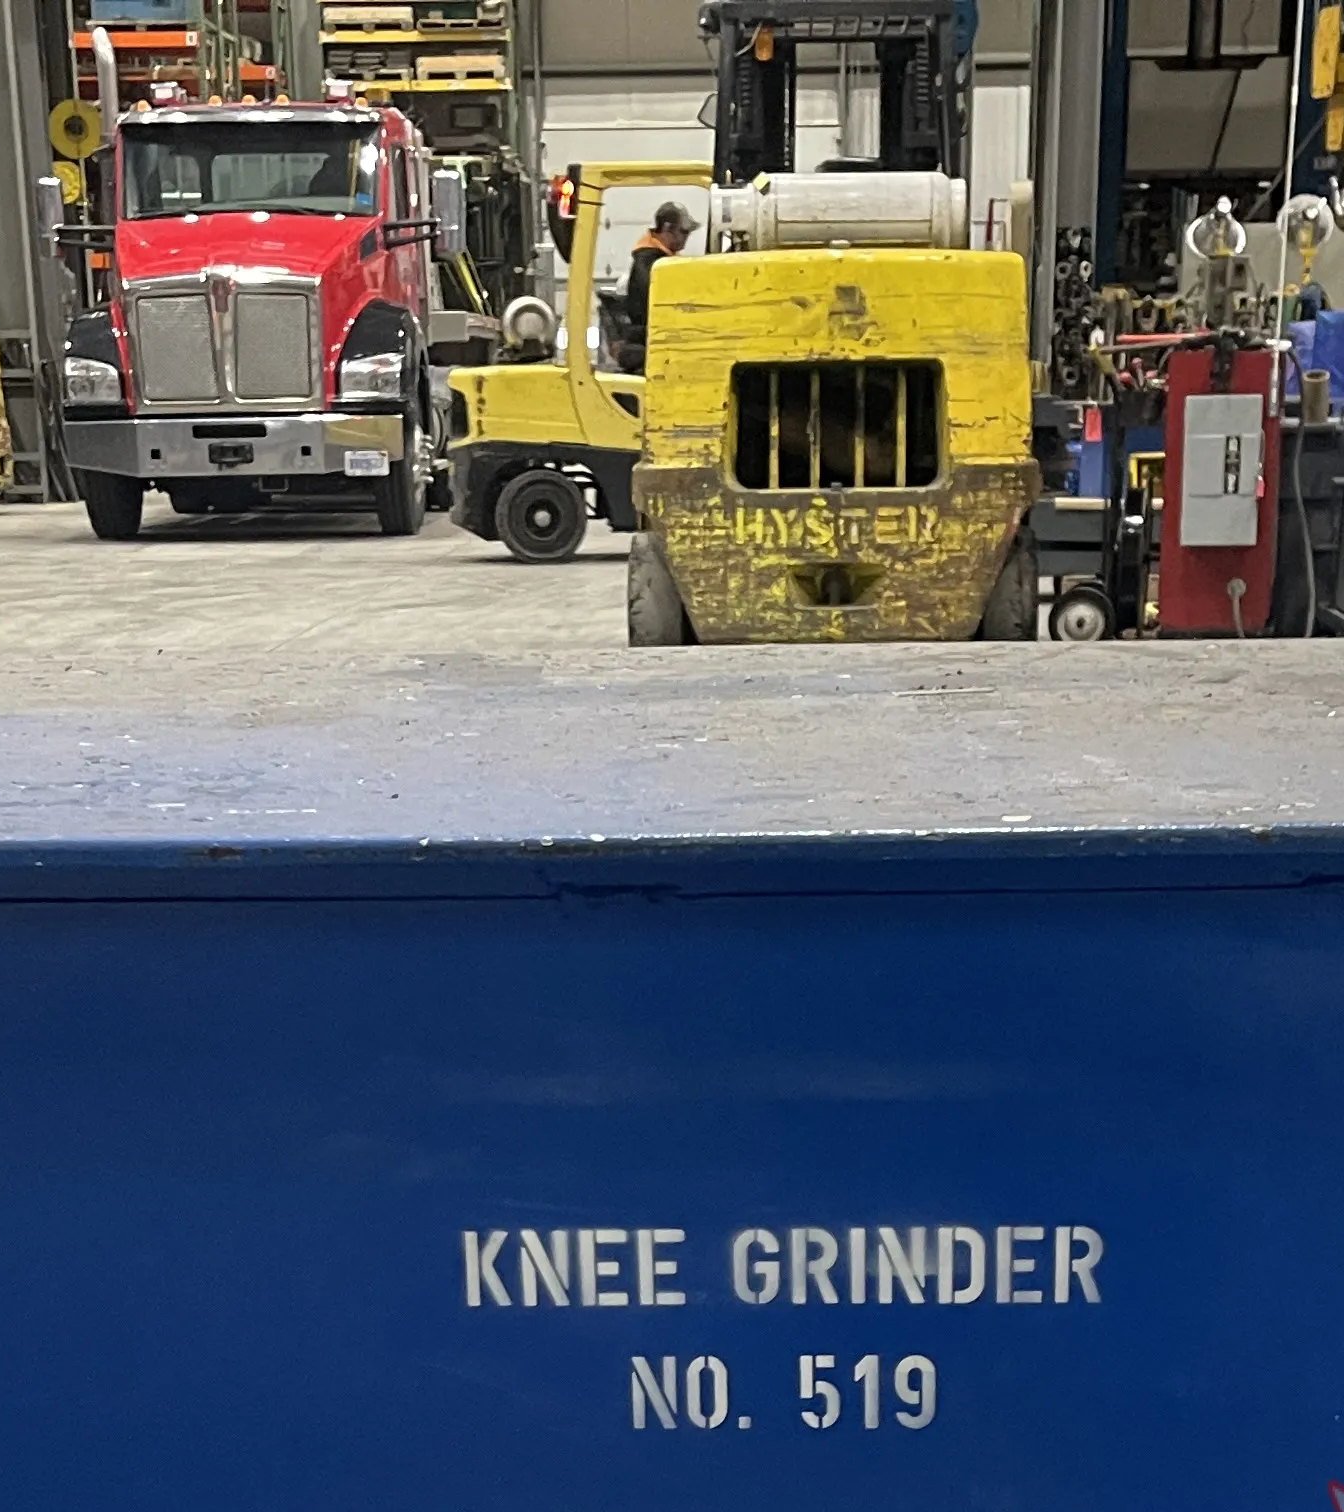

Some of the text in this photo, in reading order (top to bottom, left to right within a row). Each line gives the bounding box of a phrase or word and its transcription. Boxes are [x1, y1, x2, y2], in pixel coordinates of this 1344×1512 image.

[735, 505, 939, 547] HYSTER
[463, 1225, 1105, 1307] KNEE GRINDER
[630, 1354, 938, 1430] NO. 519
